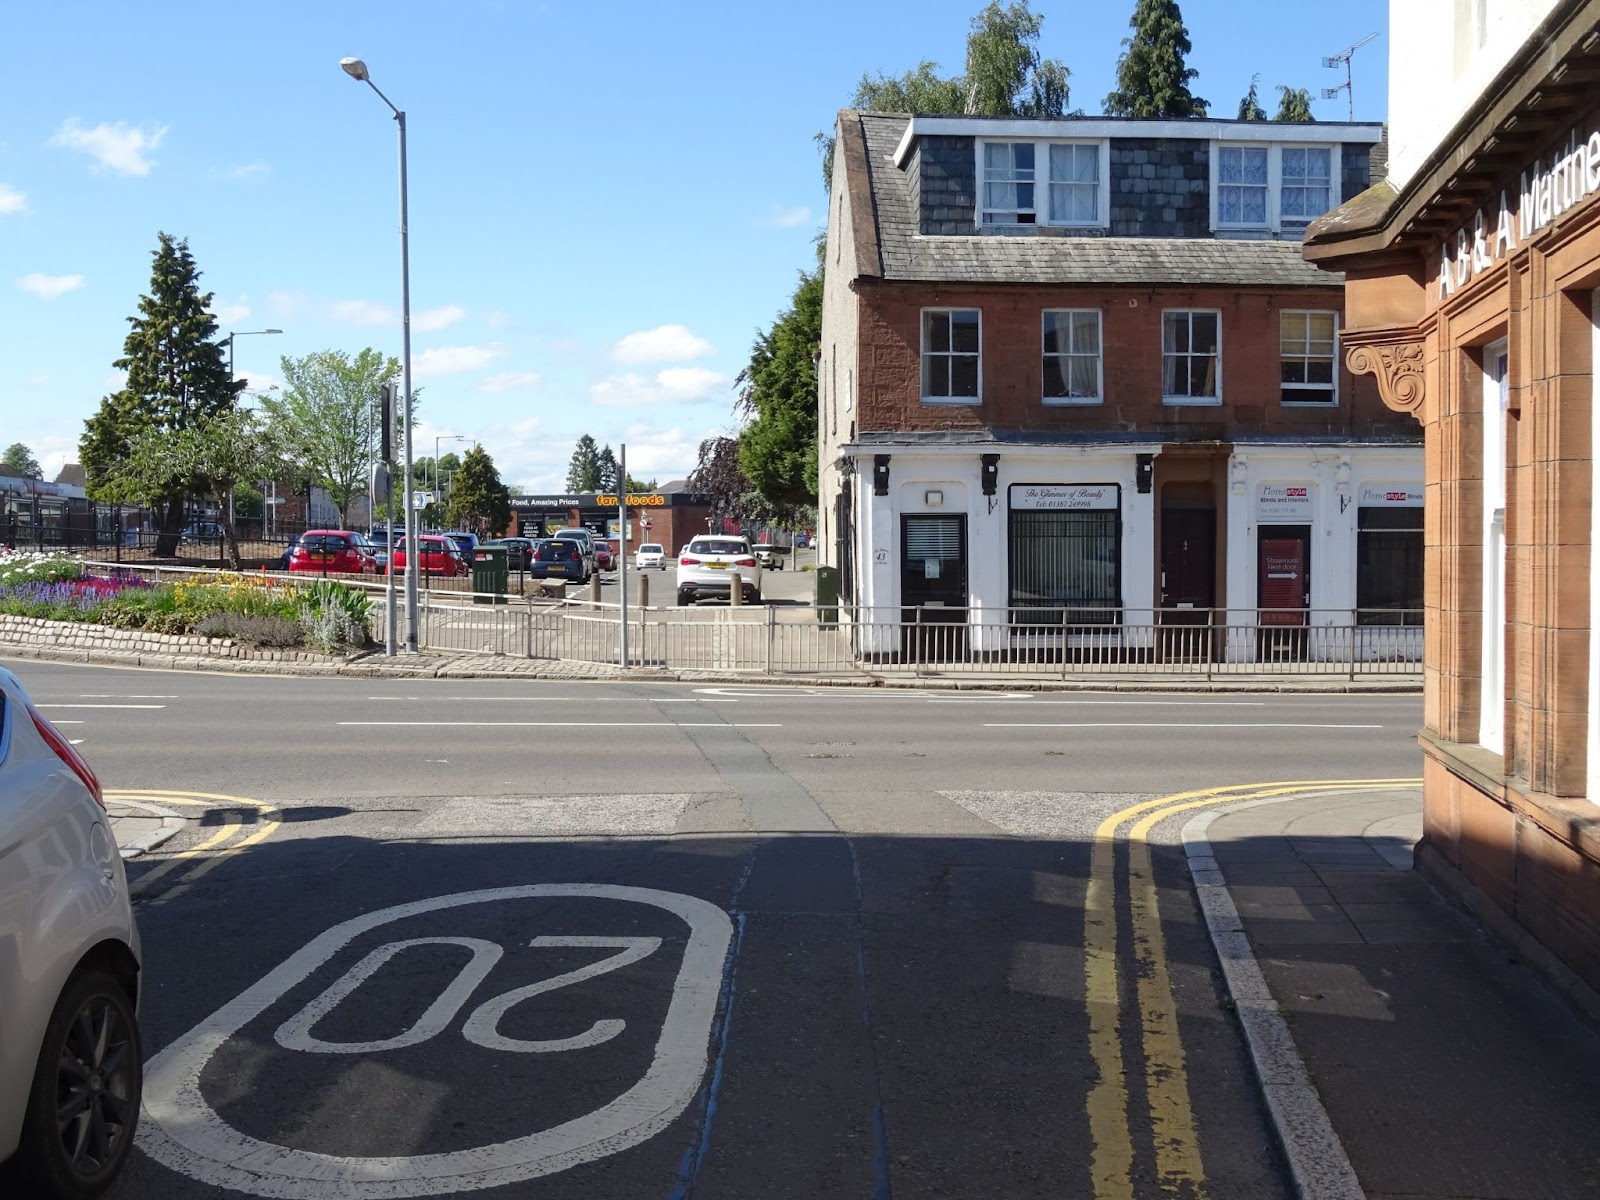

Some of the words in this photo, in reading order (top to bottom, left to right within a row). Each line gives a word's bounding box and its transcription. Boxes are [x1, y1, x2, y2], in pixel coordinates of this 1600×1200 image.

[1025, 488, 1039, 498] The
[1039, 487, 1067, 500] Glimmer
[1068, 489, 1078, 499] of
[1077, 488, 1105, 500] Beauty
[1263, 486, 1307, 497] Homestyle
[1363, 490, 1406, 501] Homestyle
[511, 499, 530, 507] Food,
[531, 499, 558, 507] Amazing
[597, 494, 664, 506] farfoods
[876, 553, 886, 561] 43
[273, 935, 663, 1054] 20
